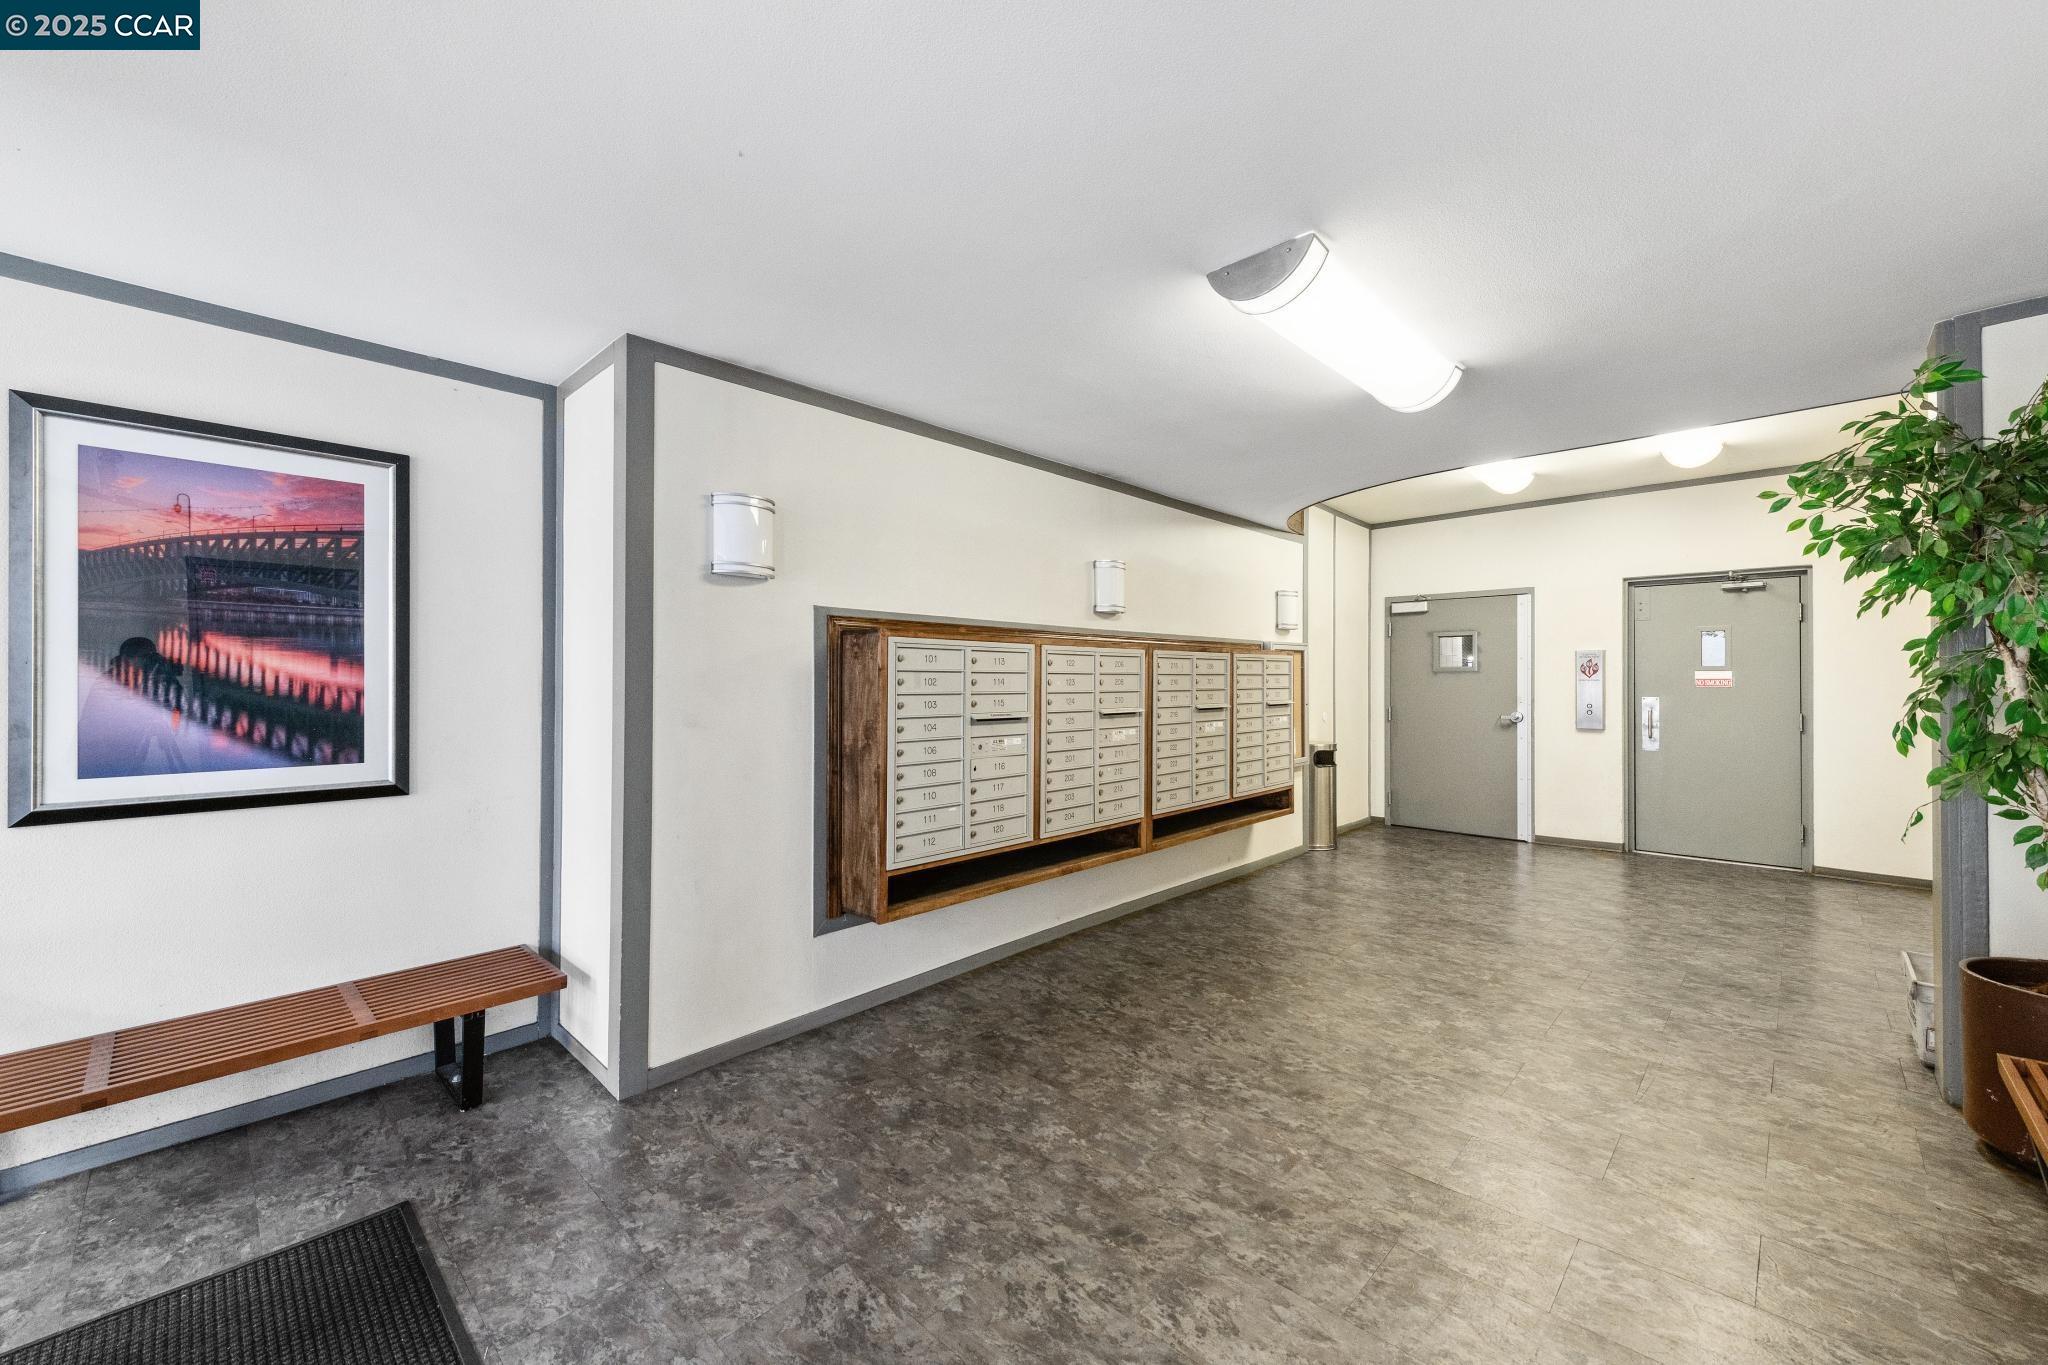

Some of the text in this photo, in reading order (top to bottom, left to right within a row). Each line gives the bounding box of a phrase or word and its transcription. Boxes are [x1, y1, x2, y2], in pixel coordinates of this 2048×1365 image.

[924, 678, 937, 686] 102
[924, 700, 937, 709] 103
[924, 723, 936, 732] 104
[924, 746, 937, 755] 106
[923, 769, 936, 777] 108
[993, 783, 1004, 791] 117
[923, 792, 936, 800] 110
[1064, 793, 1074, 801] 203
[924, 814, 936, 824] 111
[1064, 812, 1074, 821] 204
[993, 824, 1004, 833] 120
[923, 837, 936, 846] 112
